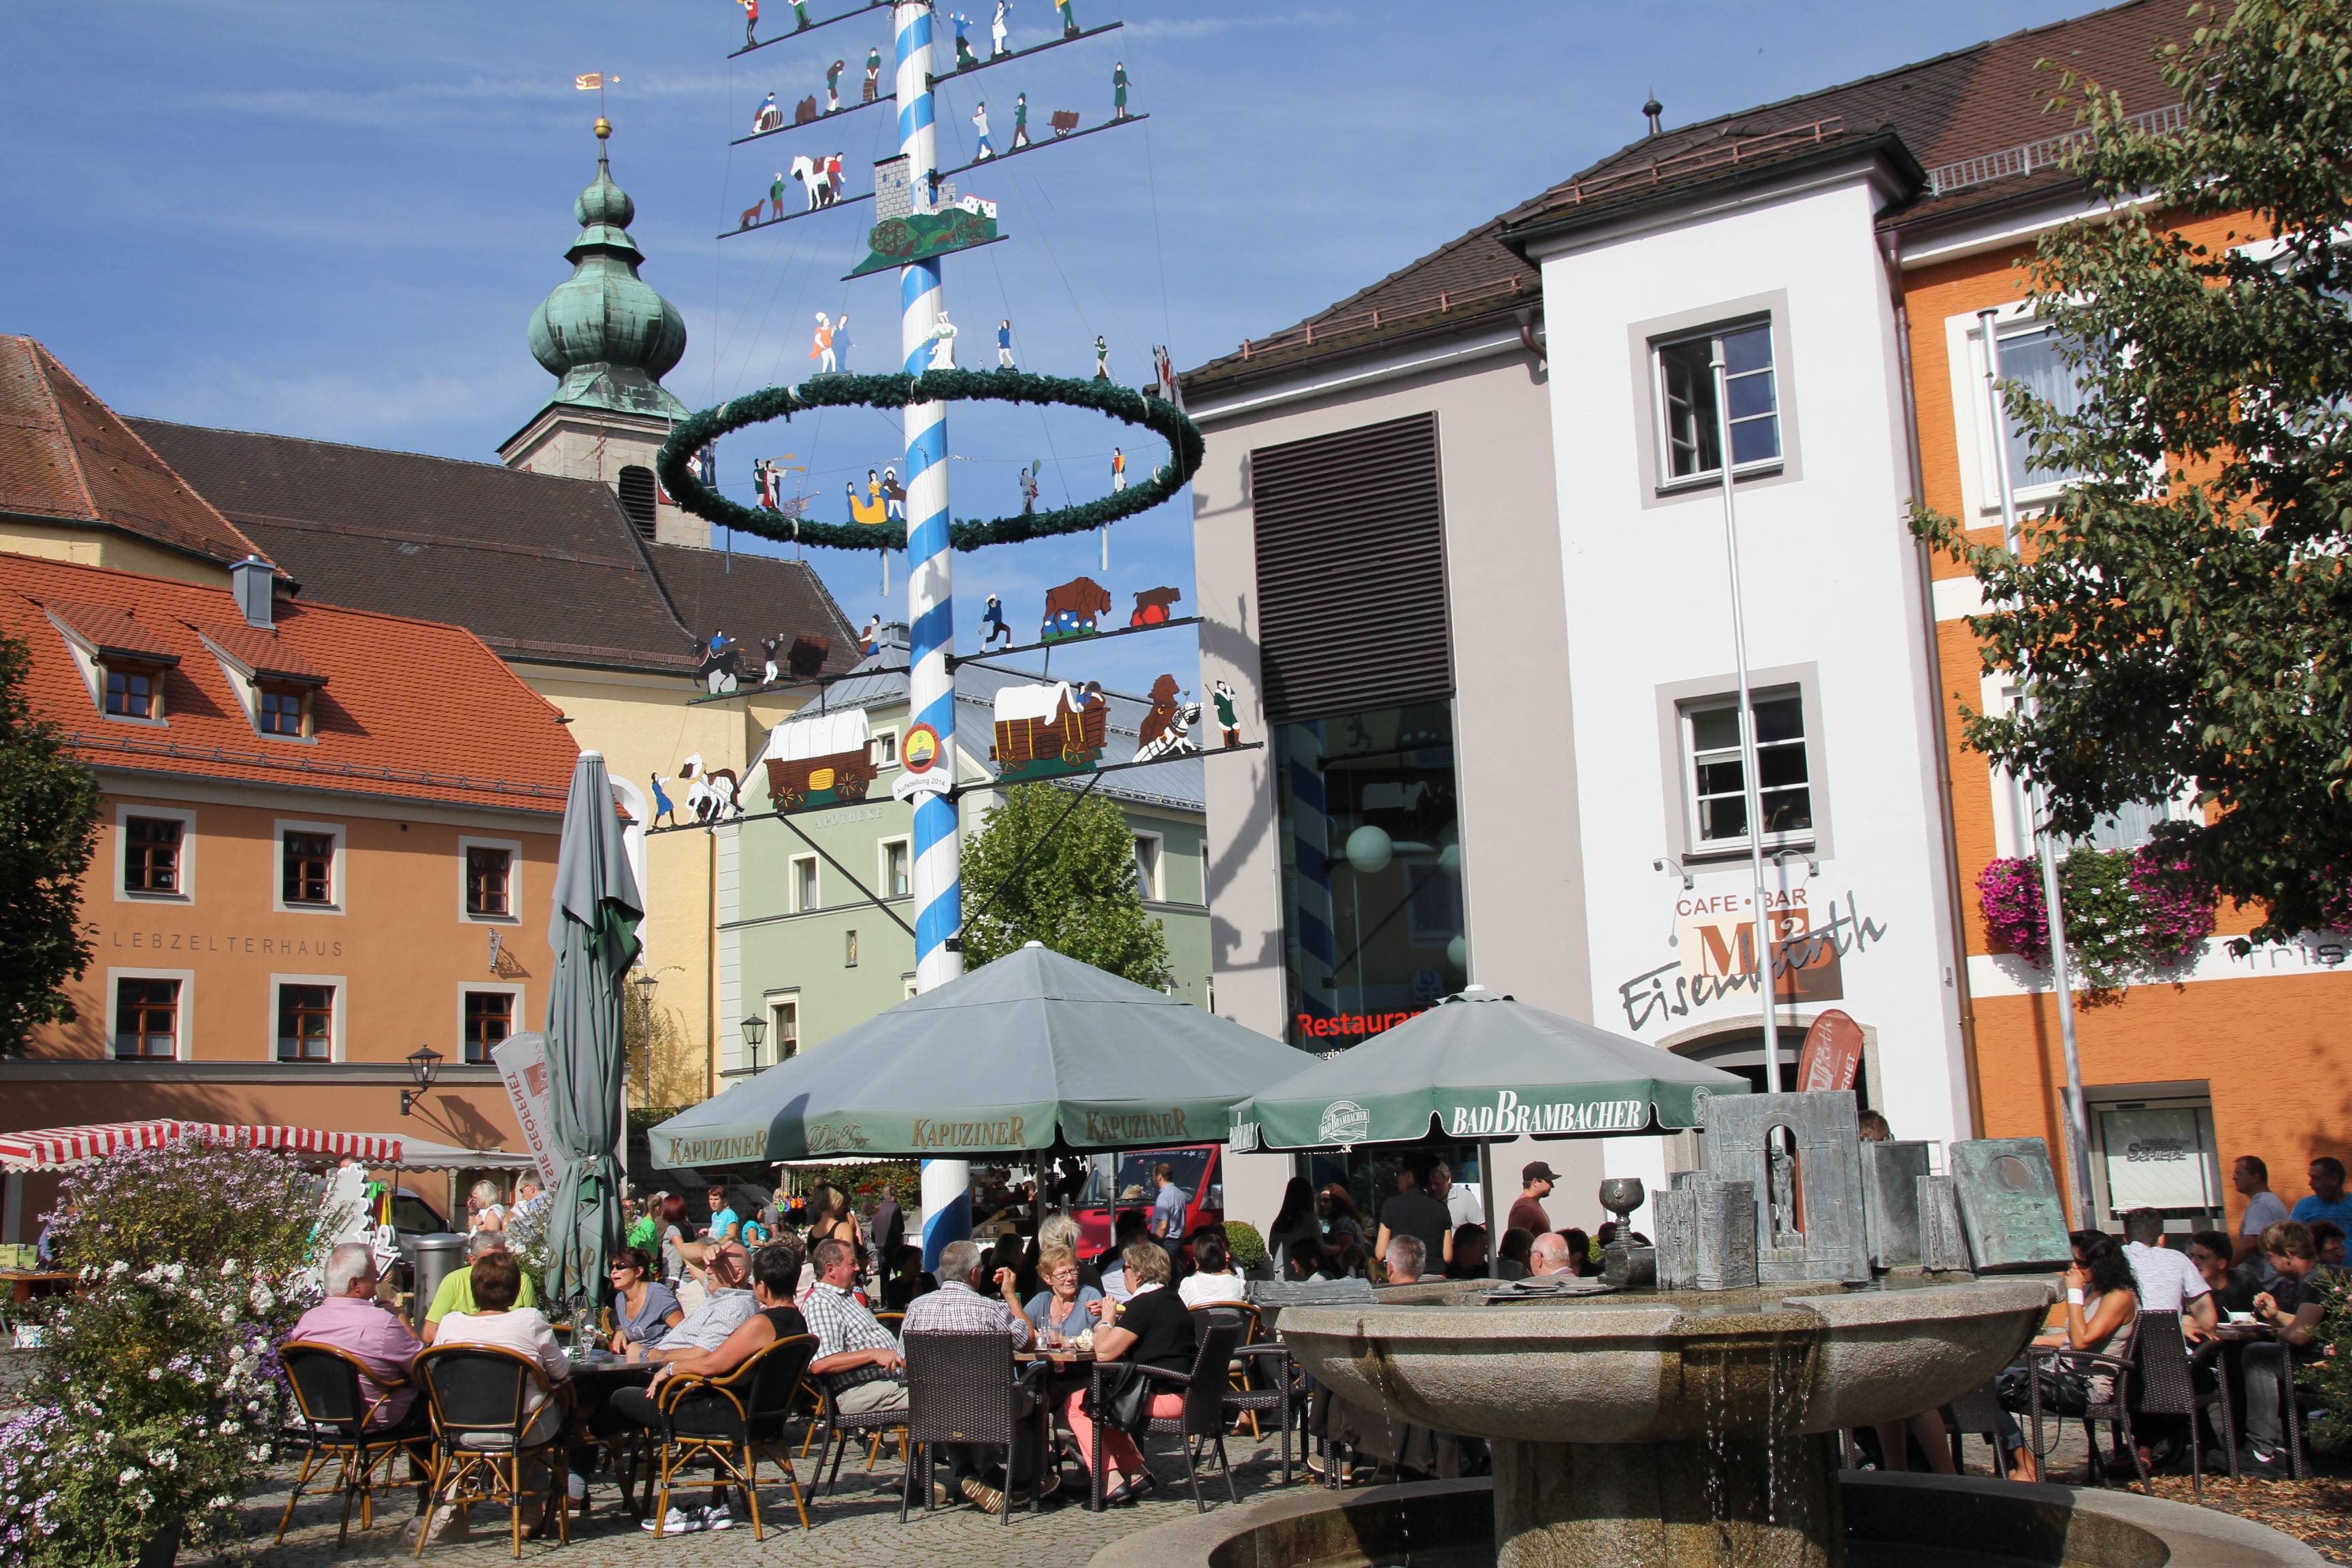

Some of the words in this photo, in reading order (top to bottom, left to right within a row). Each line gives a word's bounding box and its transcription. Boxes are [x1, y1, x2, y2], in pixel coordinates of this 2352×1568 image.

[896, 777, 930, 795] Aufstellung
[931, 777, 945, 787] 2014
[814, 806, 885, 830] APOTHEKE
[1676, 894, 1739, 917] CAFE
[1765, 887, 1808, 909] BAR
[112, 931, 344, 957] LEBZELTERHAUS
[911, 1115, 1026, 1149] KAPUZINER
[1084, 1107, 1192, 1144] KAPUZINER
[667, 1130, 768, 1165] KAPUZINER
